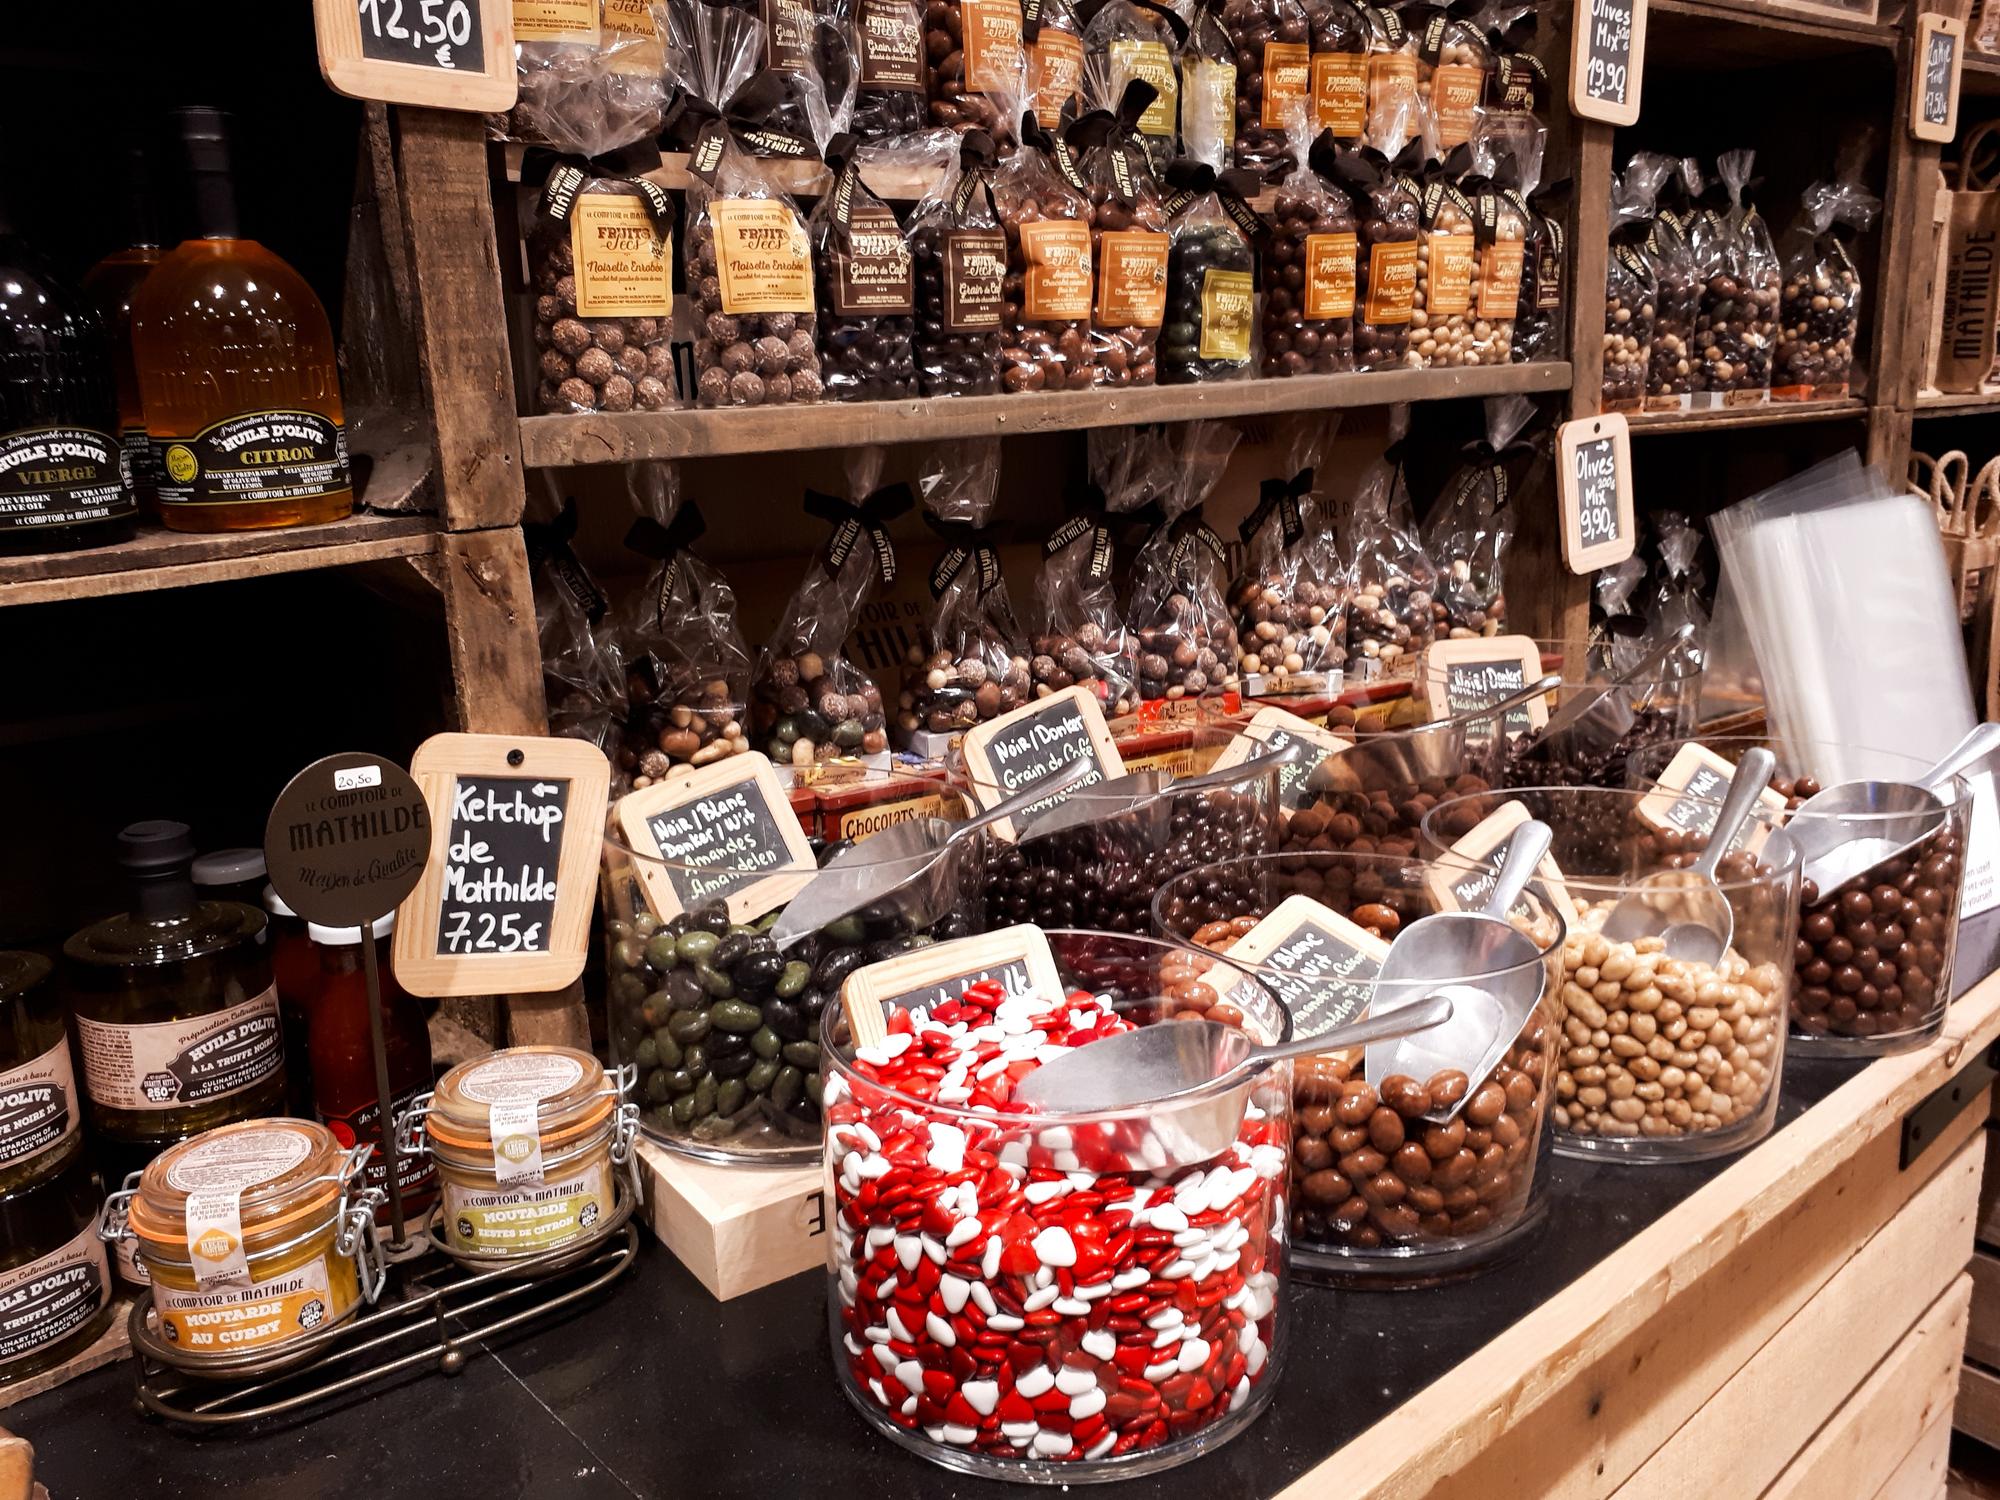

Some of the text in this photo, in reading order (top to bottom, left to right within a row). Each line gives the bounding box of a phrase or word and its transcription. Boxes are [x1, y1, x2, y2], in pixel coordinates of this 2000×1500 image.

[360, 0, 472, 49] 12,50
[1592, 0, 1630, 25] Olives
[435, 44, 455, 68] €
[1588, 56, 1626, 93] 19,90
[701, 136, 724, 172] MATHILDE
[1114, 150, 1133, 198] MATHILDE
[550, 167, 584, 220] MATHILDE
[837, 168, 854, 224] MATHILDE
[598, 226, 651, 240] FRUITS
[587, 260, 663, 272] Noisette Enrobée
[730, 260, 804, 272] Noisette Enrobée
[850, 262, 907, 280] Grain de Café
[959, 282, 983, 299] Grain
[1953, 231, 1995, 359] MATHILDE
[222, 425, 324, 452] HUILE D'OLIVE
[49, 443, 107, 464] D'OLIVE
[240, 446, 316, 465] CITRON
[1576, 451, 1614, 480] Olives
[17, 465, 97, 485] VIERGE
[235, 469, 278, 477] PREPARATION
[15, 494, 51, 504] VIRGIN
[27, 502, 45, 510] OIL
[70, 488, 99, 498] EXTRA
[248, 488, 284, 499] COMPTOIR
[293, 485, 324, 496] MATHILDE
[24, 513, 65, 525] COMPTOIR
[75, 508, 110, 519] MATHILDE
[831, 517, 860, 567] MATHILDE
[1047, 516, 1092, 552] MATHILDE
[1197, 527, 1226, 562] MATHILDE
[873, 529, 893, 583] MATHILDE
[1090, 527, 1108, 578] MATHILDE
[1170, 532, 1190, 578] MATHILDE
[934, 547, 967, 590] MATHILDE
[979, 548, 993, 590] MATHILDE
[338, 772, 372, 790] 20,50
[1003, 763, 1047, 795] Grain
[1049, 754, 1064, 772] de
[320, 786, 387, 812] COMPTOIR
[453, 783, 563, 843] Ketchup
[289, 802, 425, 852] MATHILDE
[846, 807, 914, 840] Chocolats
[449, 829, 494, 864] de
[684, 832, 757, 877] Amandes
[353, 871, 365, 884] de
[443, 864, 556, 903] Mathilde
[691, 850, 777, 901] Amandelen
[1273, 933, 1324, 969] Blanc
[180, 1017, 229, 1044] Préparation
[188, 1017, 276, 1062] HUILE D'OLIVE
[201, 1037, 273, 1072] LA TRUFFE NOIRE
[190, 1087, 212, 1097] OLIVE
[214, 1084, 226, 1092] OIL
[226, 1079, 243, 1088] WITH
[202, 1073, 237, 1088] CULINARY
[13, 1102, 56, 1130] NOIRE 1%
[11, 1142, 34, 1156] BLACK
[35, 1128, 60, 1145] TRUFFLE
[43, 1126, 51, 1135] OF
[470, 1193, 519, 1207] COMPTOIR
[523, 1194, 532, 1202] DE
[535, 1181, 585, 1202] MATHILDE
[478, 1216, 574, 1238] ZESTES DE CITRON
[482, 1202, 568, 1224] MOUTARDE
[19, 1261, 59, 1280] Culinaire
[66, 1252, 82, 1262] base
[30, 1267, 86, 1297] D'OLIVE
[172, 1295, 223, 1308] COMPTOIR
[227, 1295, 238, 1303] DE
[241, 1277, 304, 1302] MATHILDE
[3, 1280, 91, 1331] TRUFFE NOIRE 1%
[184, 1301, 284, 1327] MOUTARDE
[1, 1303, 95, 1355] OIL WITH 1% BLACK TRUFFLE
[31, 1303, 87, 1338] PREPARATION OF
[191, 1329, 214, 1345] AU
[219, 1319, 281, 1343] CURRY
